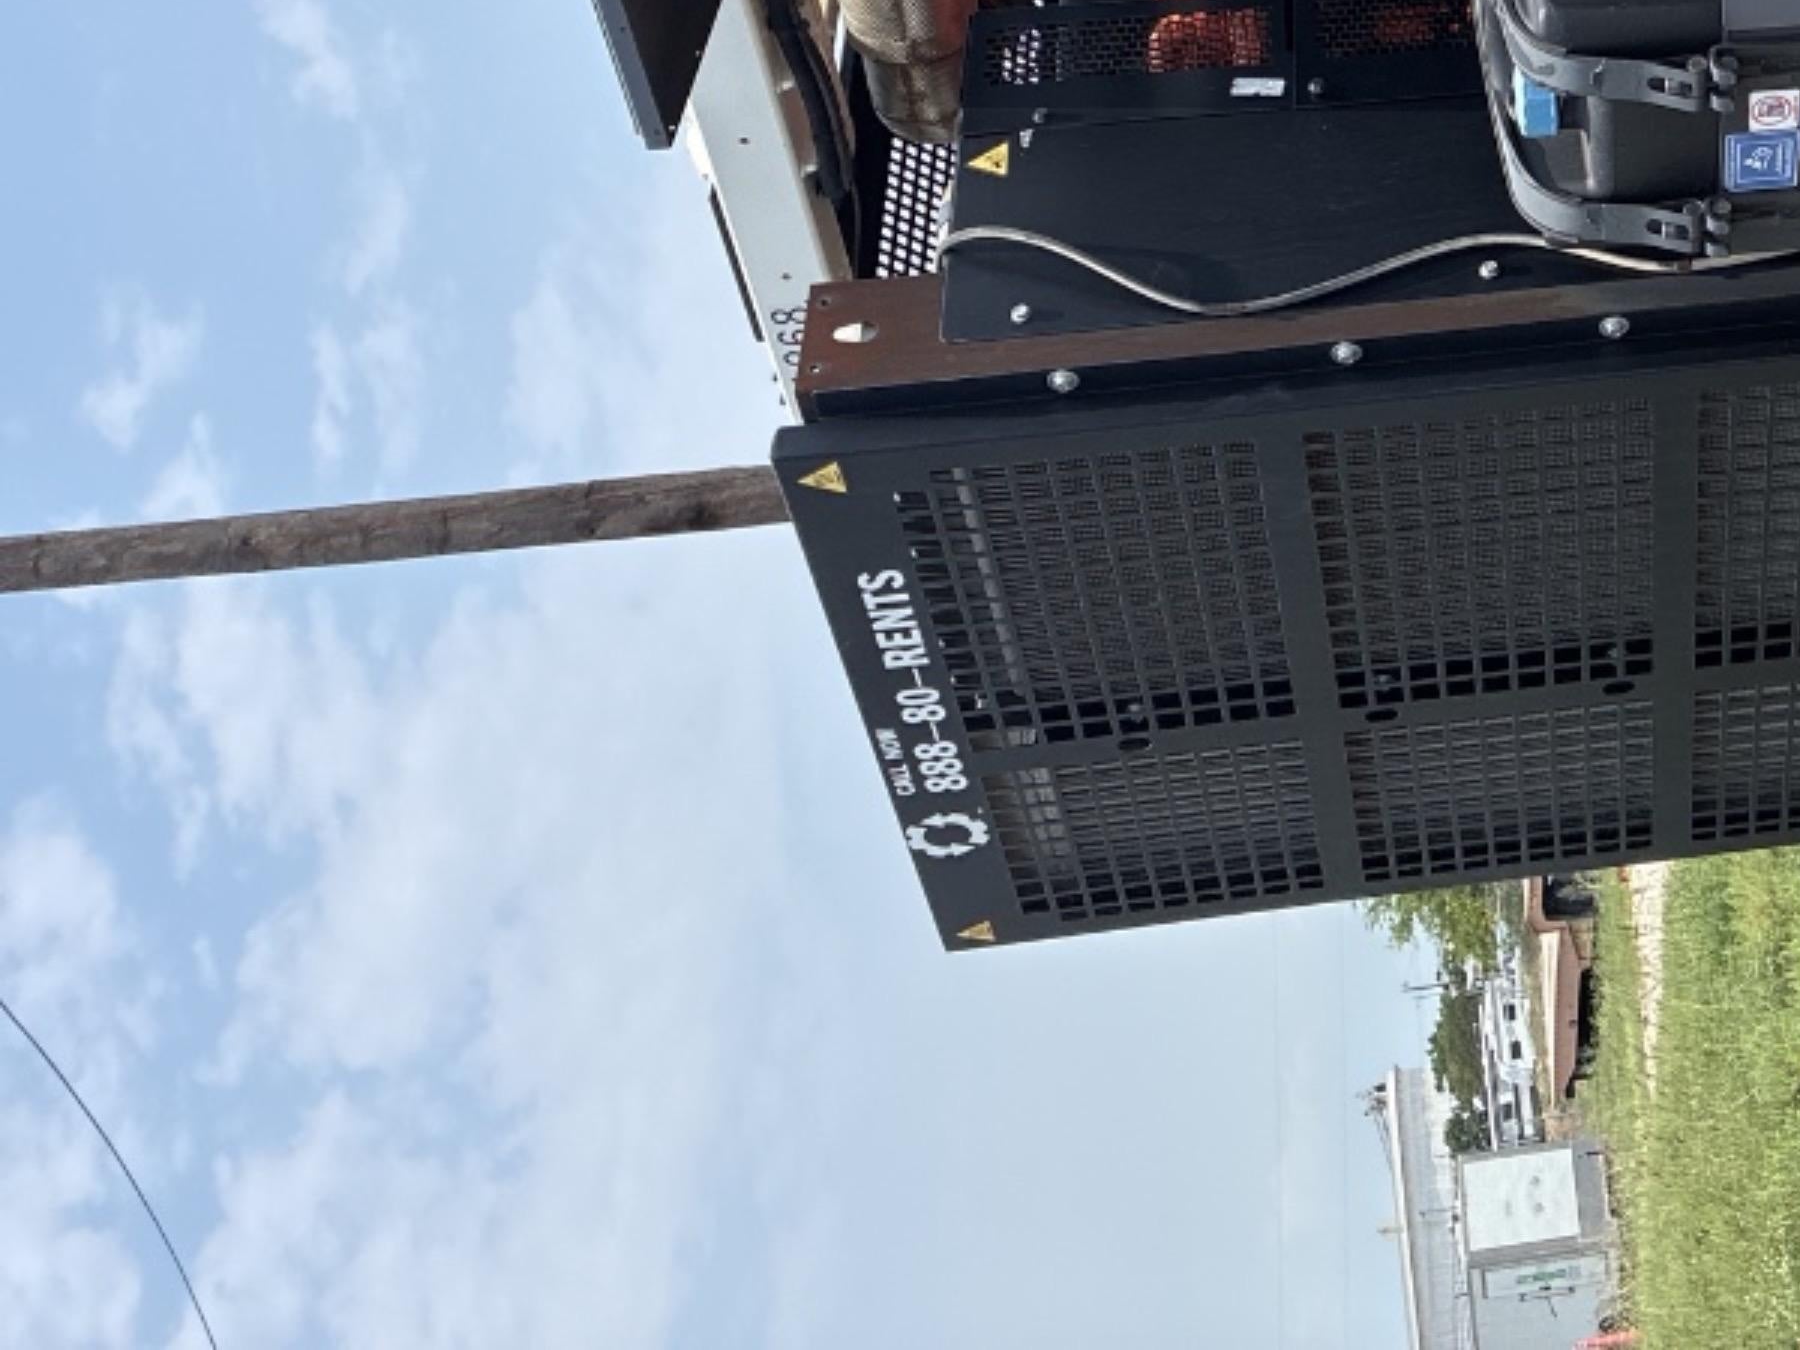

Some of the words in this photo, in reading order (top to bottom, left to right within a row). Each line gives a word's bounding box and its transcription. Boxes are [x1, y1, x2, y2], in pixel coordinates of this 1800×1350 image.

[857, 569, 969, 794] 888-80-RENTS
[875, 728, 904, 760] NOW
[888, 763, 916, 796] CALL
